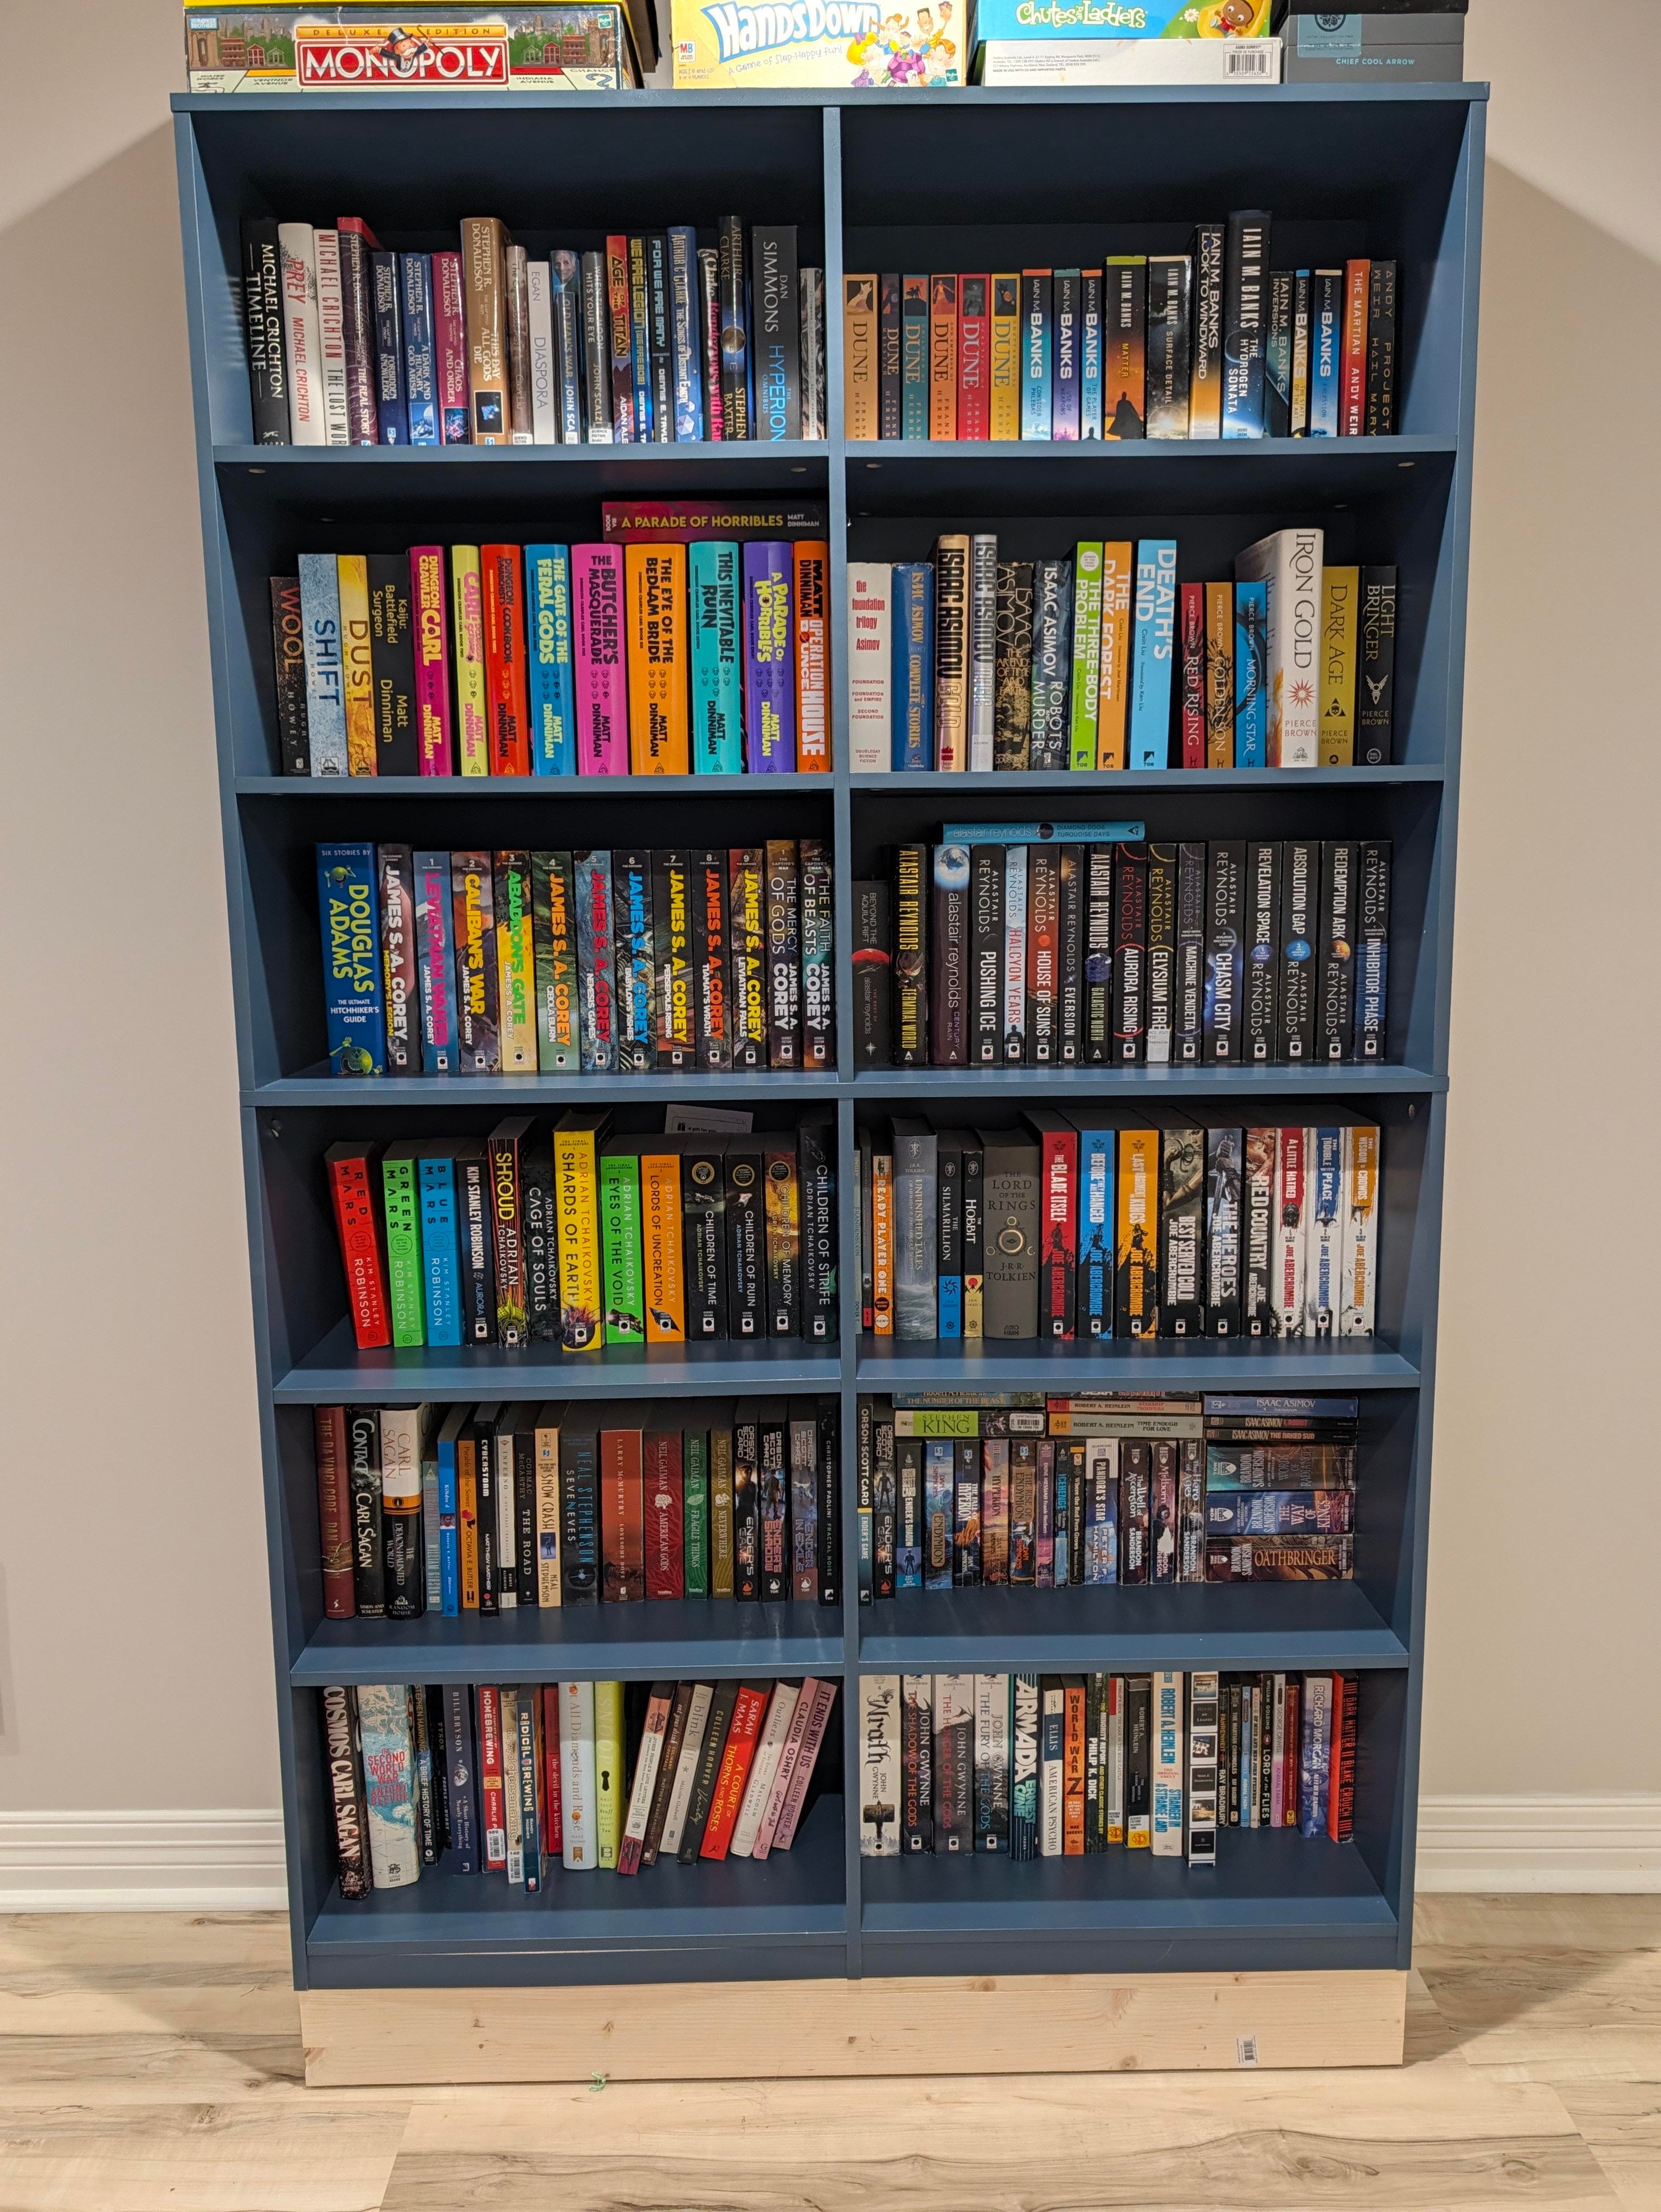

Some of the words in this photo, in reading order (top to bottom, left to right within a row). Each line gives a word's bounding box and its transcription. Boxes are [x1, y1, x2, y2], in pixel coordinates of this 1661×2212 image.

[312, 28, 382, 36] DELUXE
[1016, 1, 1077, 27] Chutes
[1083, 0, 1145, 28] Ladders
[681, 43, 693, 53] MB
[764, 56, 772, 65] of
[1243, 229, 1261, 258] IAIN
[262, 244, 276, 313] MICHAEL
[287, 259, 305, 304] PREY
[531, 271, 540, 301] EGAN
[763, 242, 778, 332] SIMMONS
[780, 275, 788, 299] DAN
[247, 274, 266, 370] TIMELINE
[1240, 285, 1259, 329] BANKS
[1352, 300, 1361, 355] MARTIAN
[267, 318, 283, 398] CRICHTON
[853, 321, 867, 383] DUNE
[963, 322, 980, 389] DUNE
[1031, 313, 1042, 378] BANKS
[535, 337, 548, 409] DIASPORA
[1351, 368, 1360, 400] ANDY
[1349, 407, 1359, 435] WEIR
[622, 517, 632, 528] A
[635, 517, 686, 528] PARADE
[690, 517, 707, 527] OF
[712, 515, 783, 527] HORRIBLES
[591, 556, 611, 565] THE
[1290, 532, 1316, 593] IRON
[852, 598, 885, 611] foundation
[857, 580, 866, 593] the
[1136, 564, 1155, 622] END
[1154, 548, 1176, 660] DEATH'S
[280, 587, 302, 673] WOOL
[373, 591, 382, 637] Surgeon
[385, 584, 398, 644] Battlefield
[398, 599, 408, 629] Kaiju:
[589, 568, 602, 665] MASQUERADE
[601, 568, 619, 665] BUTCHER'S
[856, 617, 877, 630] trilogy
[1294, 600, 1315, 669] GOLD
[314, 619, 339, 706] SHIFT
[349, 621, 372, 708] DUST
[856, 638, 880, 651] Asimov
[379, 679, 393, 743] Dinniman
[396, 695, 408, 728] Matt
[670, 869, 685, 933] JAMES
[948, 893, 961, 943] alastair
[329, 898, 352, 979] ADAMS
[348, 885, 374, 993] DOUGLAS
[945, 947, 961, 1008] reynolds
[1036, 951, 1052, 987] HOUSE
[672, 980, 687, 1042] COREY
[1036, 991, 1051, 1006] OF
[1036, 1008, 1051, 1036] SUNS
[496, 1153, 515, 1220] SHROUD
[816, 1165, 829, 1234] CHILDREN
[876, 1179, 886, 1218] READY
[989, 1200, 1035, 1211] RINGS
[993, 1180, 1032, 1189] LORD
[530, 1187, 542, 1229] CAGE
[942, 1187, 950, 1261] SILMARILLION
[965, 1199, 976, 1244] HOBBIT
[532, 1237, 544, 1259] OF
[818, 1239, 829, 1257] OF
[877, 1222, 886, 1268] PLAYER
[354, 1259, 370, 1327] ROBINSON
[533, 1263, 546, 1311] SOULS
[819, 1263, 830, 1305] STRIFE
[878, 1271, 887, 1294] ONE
[986, 1271, 1035, 1281] TOLKIEN
[923, 1420, 970, 1433] KING
[383, 1429, 396, 1479] SAGAN
[396, 1433, 411, 1476] CARL
[542, 1474, 553, 1499] SNOW
[542, 1503, 555, 1529] CRASH
[933, 1516, 943, 1564] ENDYMION
[1255, 1550, 1336, 1566] OATHBRINGER
[323, 1686, 350, 1757] COSMOS
[743, 1700, 759, 1735] SARAH
[791, 1702, 808, 1744] CLAUDIA
[1070, 1695, 1079, 1742] WORLD
[1315, 1685, 1324, 1726] RICHARD
[483, 1690, 494, 1764] HOMEBREWING
[1015, 1682, 1037, 1783] ARMADA
[1050, 1724, 1058, 1750] ELLIS
[368, 1752, 405, 1765] SECOND
[370, 1763, 404, 1773] WORLD
[780, 1747, 796, 1779] OSHRY
[1070, 1746, 1079, 1773] WAR
[1089, 1738, 1097, 1766] PHILIP
[1314, 1728, 1324, 1770] MORGAN
[331, 1760, 354, 1802] CARL
[377, 1773, 398, 1783] WAR
[1048, 1765, 1058, 1811] AMERICAN
[1067, 1778, 1083, 1796] Z
[1089, 1779, 1097, 1801] DICK
[336, 1804, 360, 1857] SAGAN
[1048, 1814, 1057, 1851] PSYCHO
